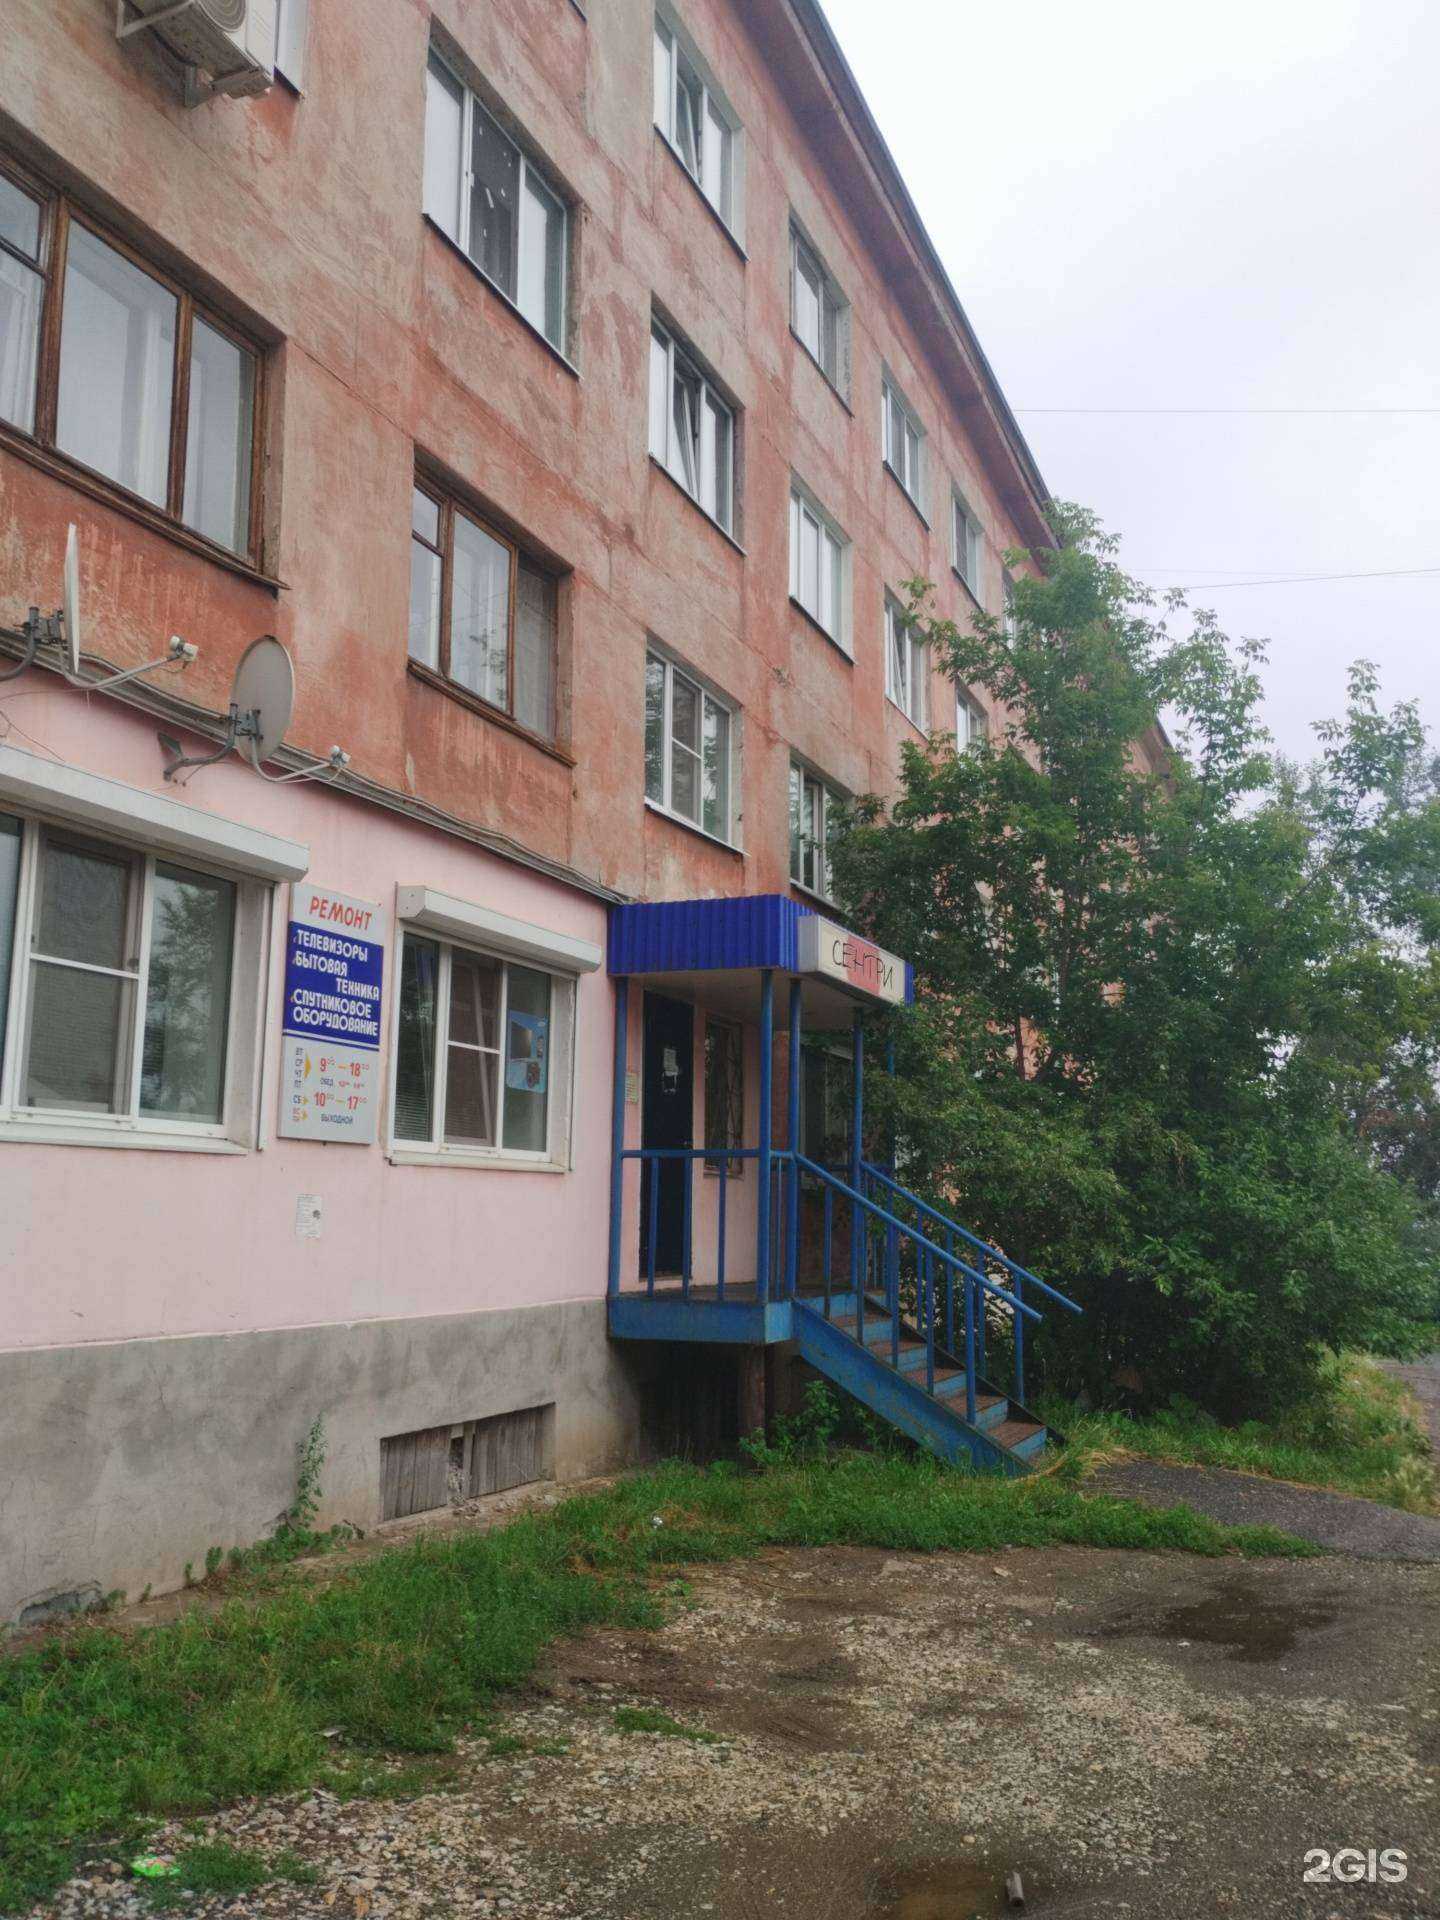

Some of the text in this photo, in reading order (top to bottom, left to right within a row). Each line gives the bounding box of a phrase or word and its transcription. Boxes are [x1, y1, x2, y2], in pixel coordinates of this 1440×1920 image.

[309, 895, 372, 931] РЕМОНТ
[297, 929, 368, 962] ТЕЛЕВИЗОРЫ
[295, 950, 348, 977] БЫТОВАЯ
[832, 940, 894, 990] СЕНТРИ
[293, 988, 372, 1019] СПУТНИКОВОЕ
[336, 977, 380, 1001] ТЕХНИКА
[293, 1006, 378, 1036] ОБОРУДОВАНИЕ
